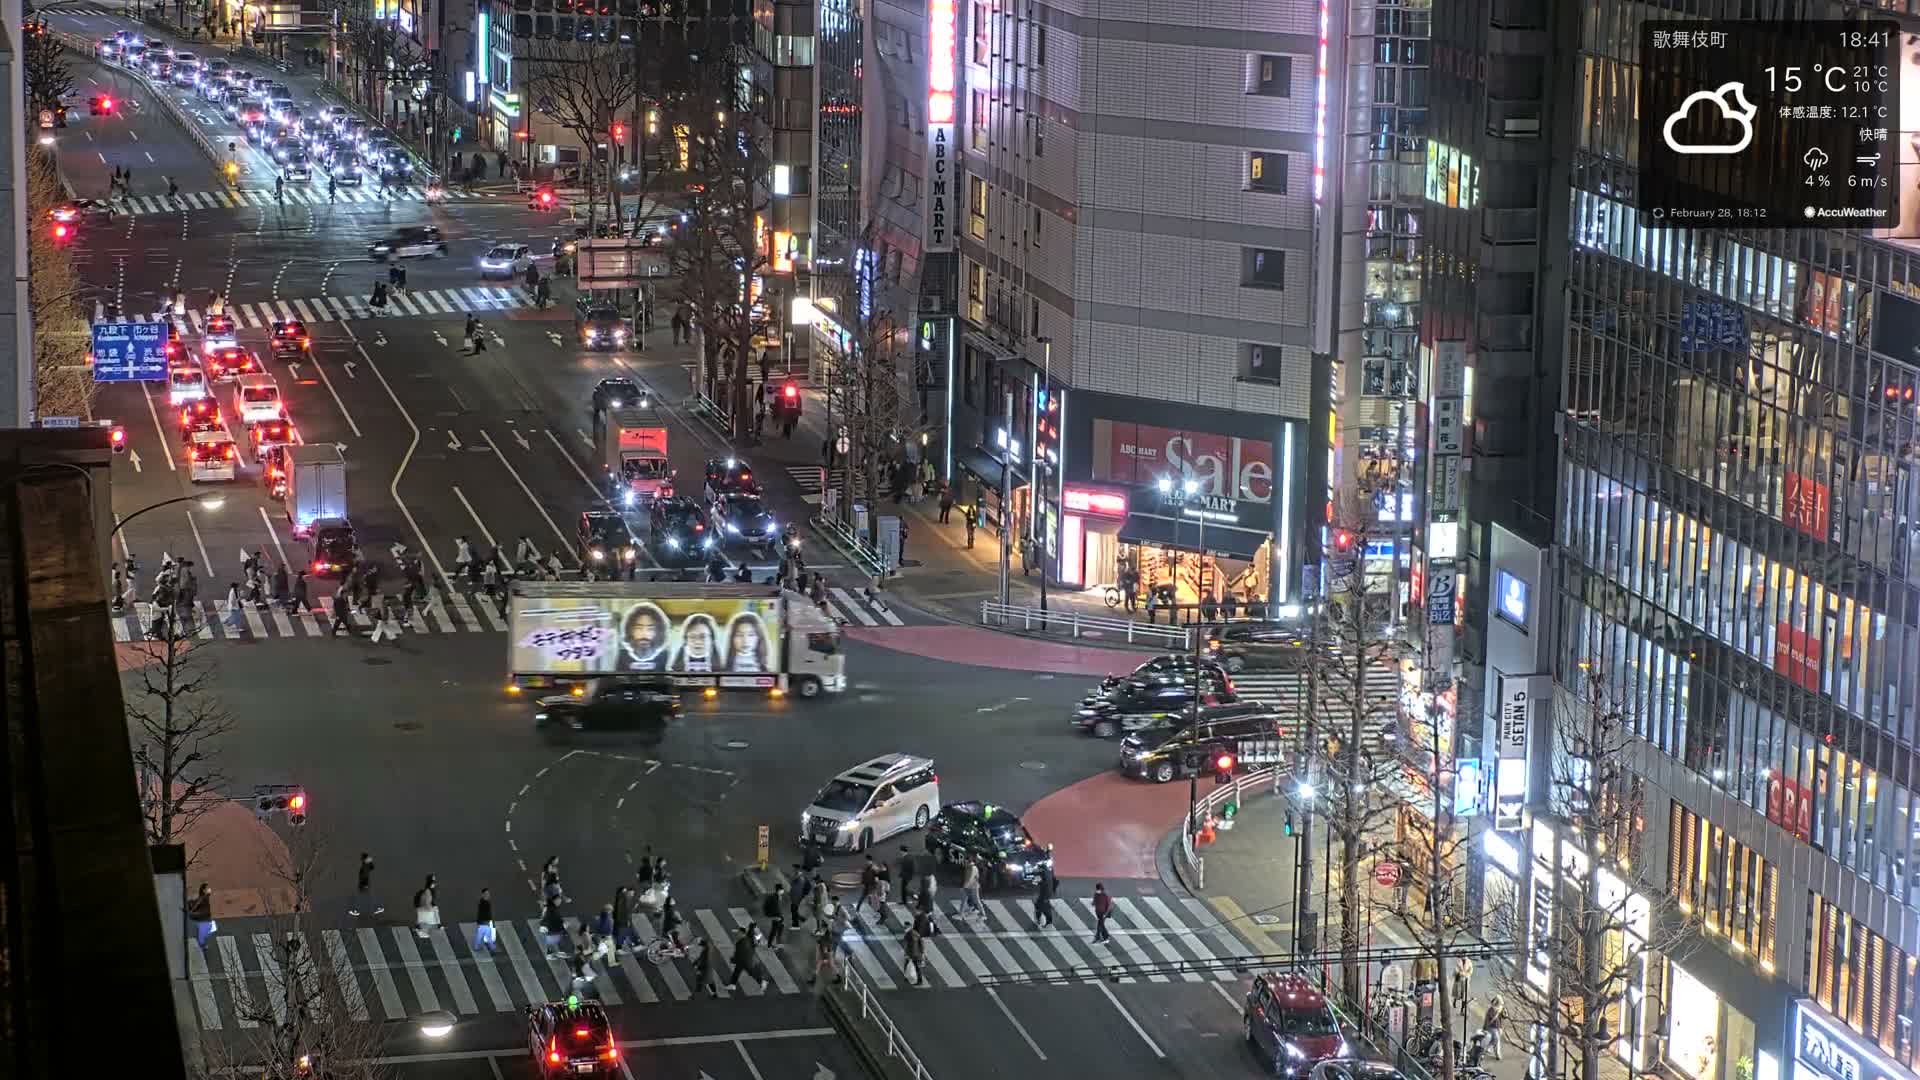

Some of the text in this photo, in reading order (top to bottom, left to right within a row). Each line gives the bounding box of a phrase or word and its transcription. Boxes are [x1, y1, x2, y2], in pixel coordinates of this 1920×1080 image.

[1166, 434, 1273, 505] Sale
[1503, 702, 1513, 740] PARK CITY
[1511, 690, 1526, 747] ISETAN 5
